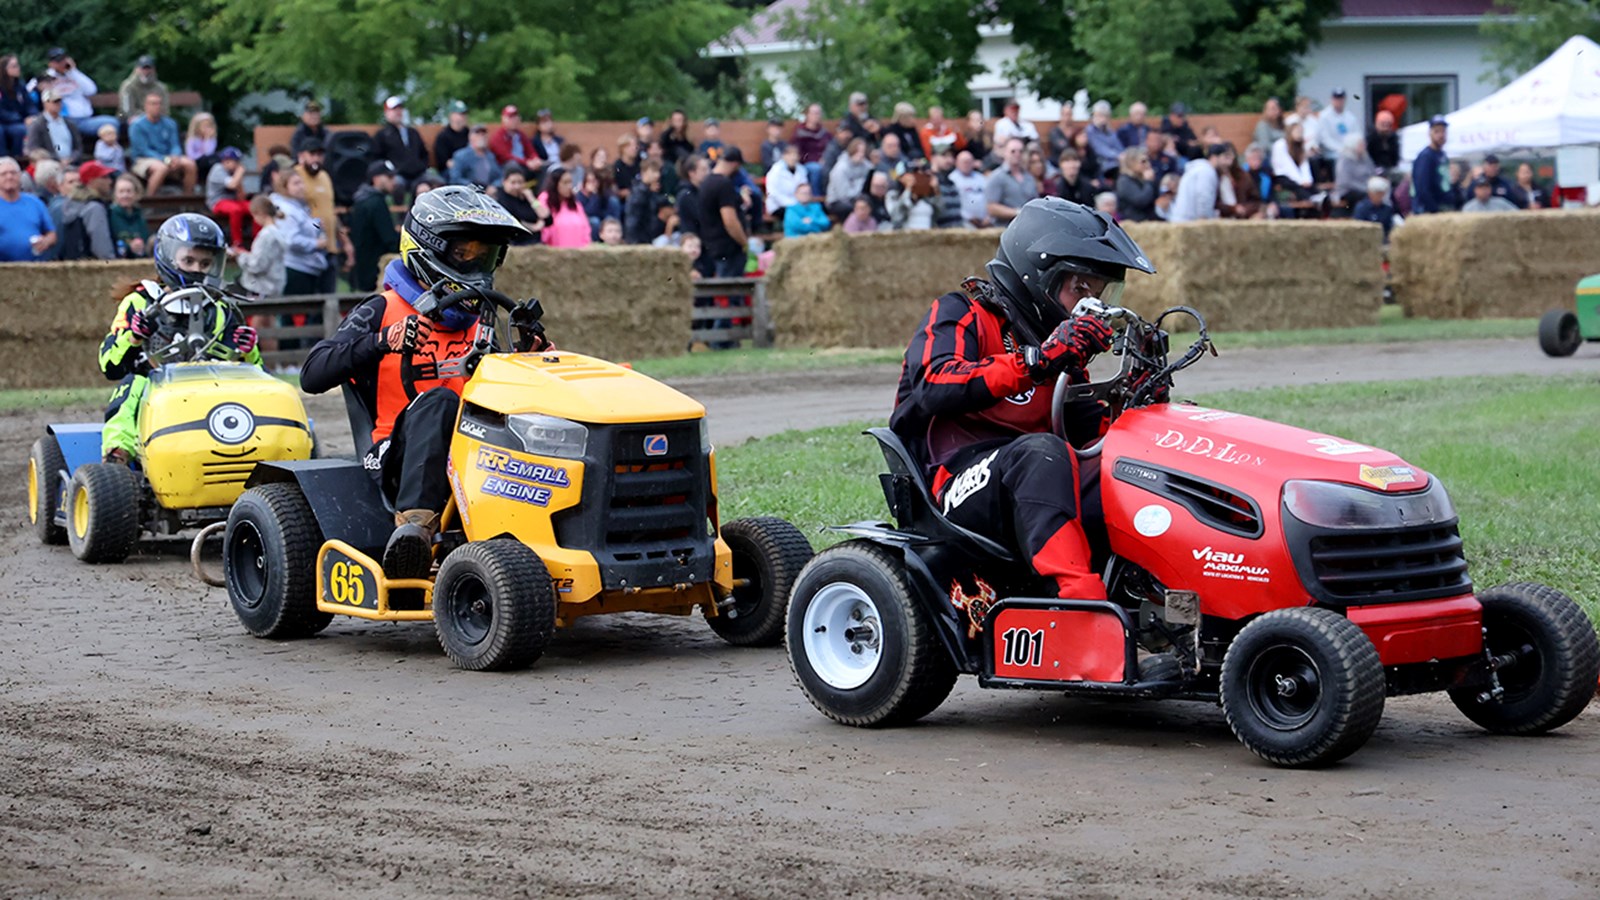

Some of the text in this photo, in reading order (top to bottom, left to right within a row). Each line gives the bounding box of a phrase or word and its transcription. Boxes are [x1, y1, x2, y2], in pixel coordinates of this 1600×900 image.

[419, 228, 444, 249] FXR
[404, 318, 418, 348] FOX
[478, 447, 510, 472] RR
[507, 460, 567, 484] SMALL
[483, 477, 550, 502] ENGINE
[330, 561, 365, 606] 65
[552, 578, 575, 588] T2
[1002, 627, 1045, 667] 101
